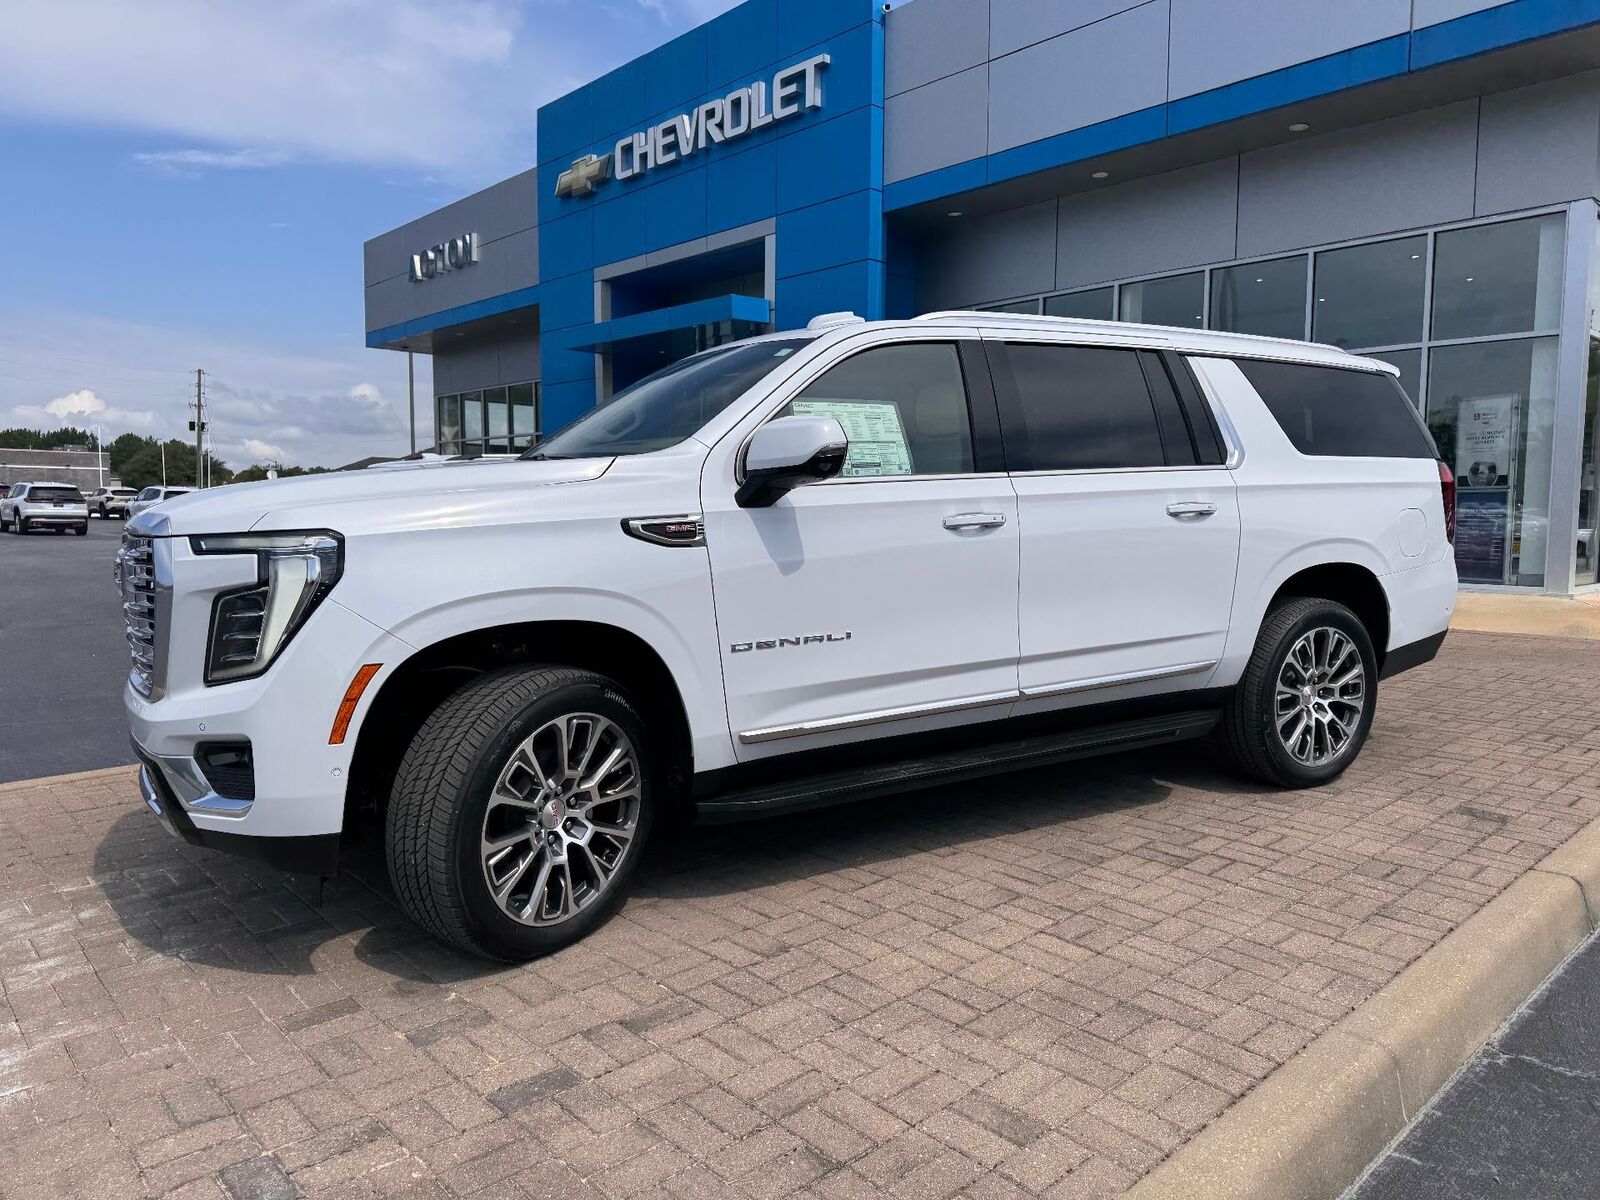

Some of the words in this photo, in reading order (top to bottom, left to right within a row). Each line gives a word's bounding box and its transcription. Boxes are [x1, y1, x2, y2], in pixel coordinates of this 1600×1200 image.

[614, 53, 831, 181] CHEVROLET
[408, 232, 479, 283] ACTION
[666, 523, 696, 533] GMC
[731, 631, 852, 654] DENALI
[550, 801, 561, 827] GMC
